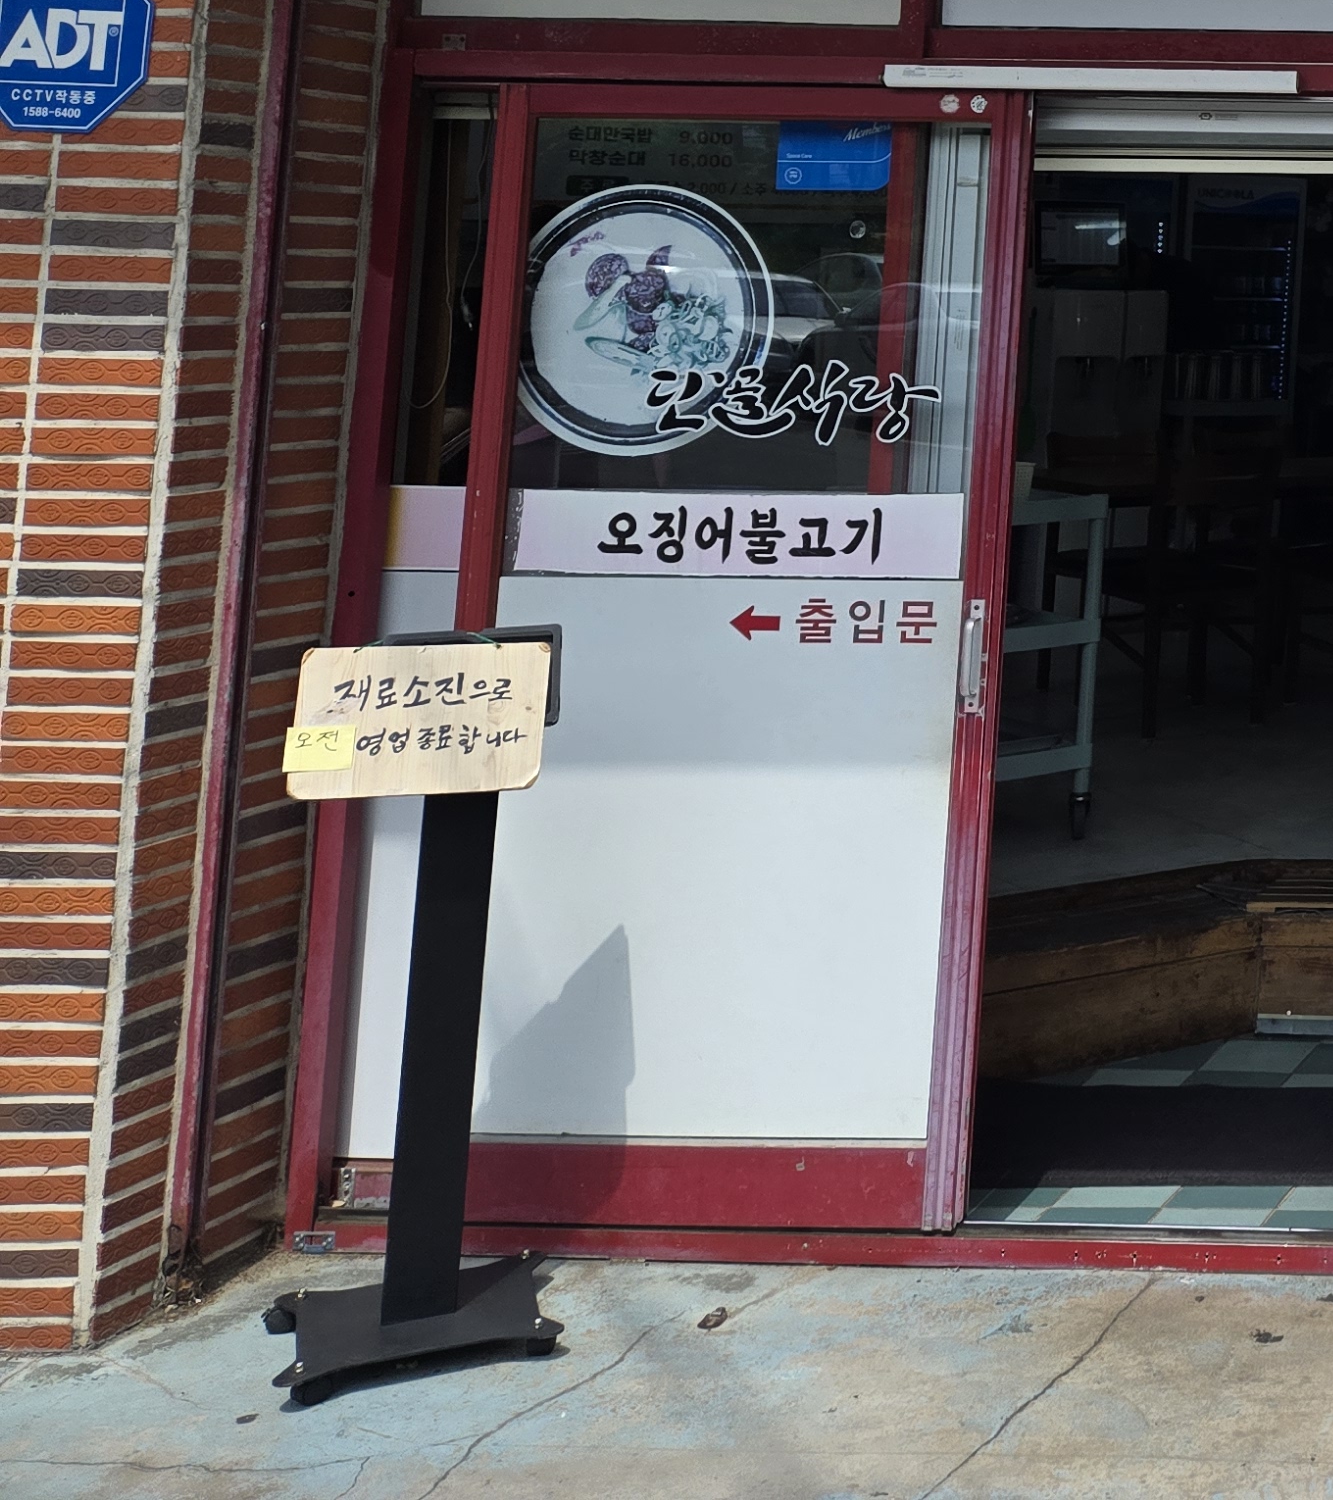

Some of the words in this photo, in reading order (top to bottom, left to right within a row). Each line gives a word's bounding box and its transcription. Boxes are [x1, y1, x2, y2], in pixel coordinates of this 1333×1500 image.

[0, 8, 123, 72] ADT
[10, 87, 97, 105] CCTV작동중
[22, 105, 82, 120] 1588-6400
[568, 149, 647, 167] 막창순대
[666, 153, 734, 169] 16,000
[646, 359, 942, 446] 단골식당
[596, 504, 884, 566] 오징어불고기
[795, 597, 939, 644] 출입문
[294, 730, 339, 752] 오전
